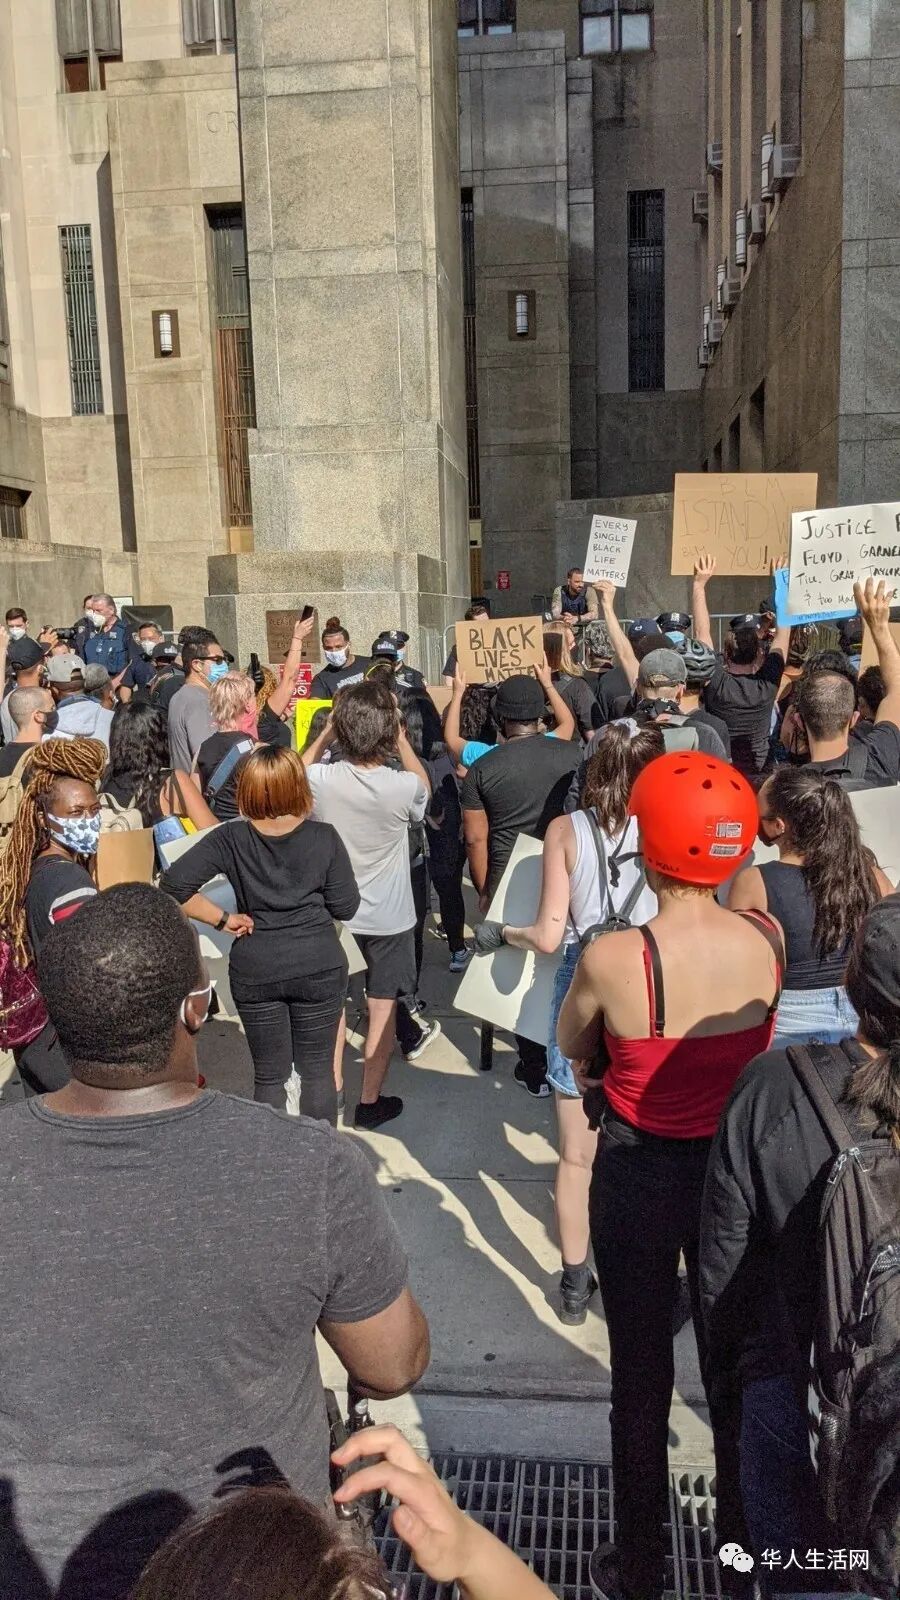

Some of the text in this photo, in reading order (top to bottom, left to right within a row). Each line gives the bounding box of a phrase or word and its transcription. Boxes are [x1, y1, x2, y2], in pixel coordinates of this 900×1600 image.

[594, 519, 629, 532] EVERY
[593, 531, 629, 543] SINGLE
[592, 543, 622, 553] BLACK
[594, 555, 617, 565] LIFE
[586, 568, 626, 581] MATTERS
[469, 623, 537, 651] BLACK
[474, 648, 522, 668] LIVES
[484, 665, 537, 683] MATTE
